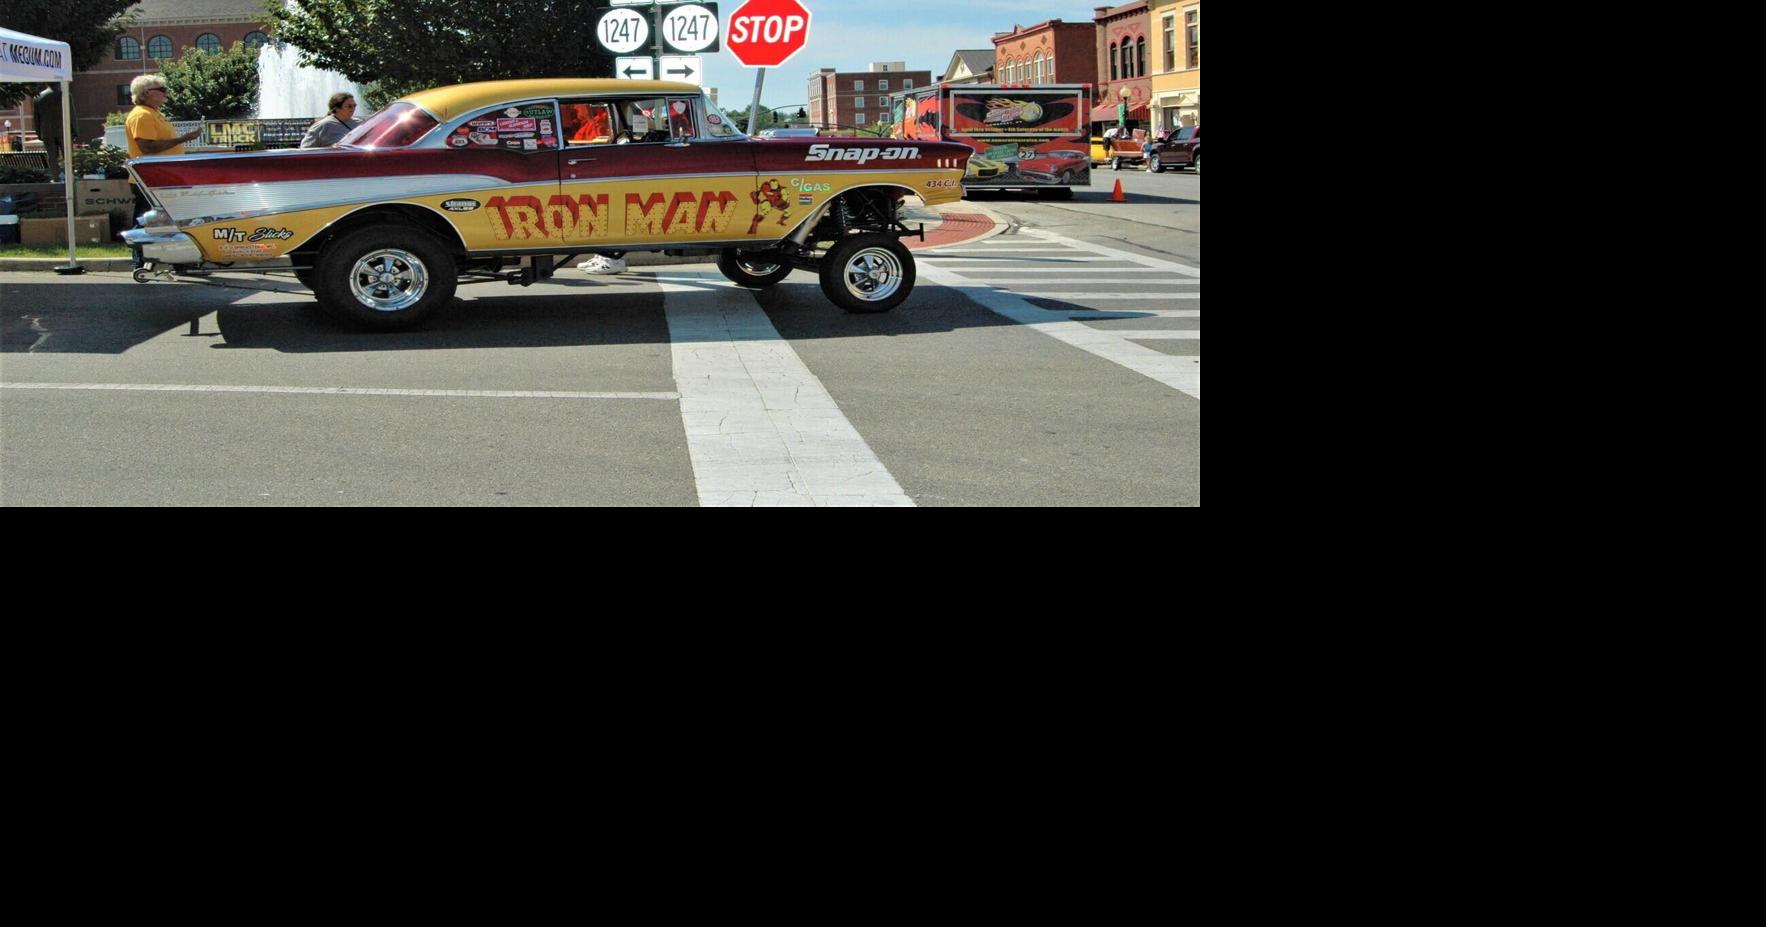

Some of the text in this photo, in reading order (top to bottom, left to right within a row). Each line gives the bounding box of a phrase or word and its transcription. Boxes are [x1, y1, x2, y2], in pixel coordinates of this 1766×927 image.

[603, 18, 640, 43] 1247
[670, 15, 710, 41] 1247
[731, 15, 804, 44] STOP
[210, 123, 256, 135] LMC
[210, 134, 256, 143] TRUCK
[790, 177, 831, 192] C/GAS
[484, 190, 739, 241] IRON MAN
[213, 227, 294, 242] M/T Slicks
